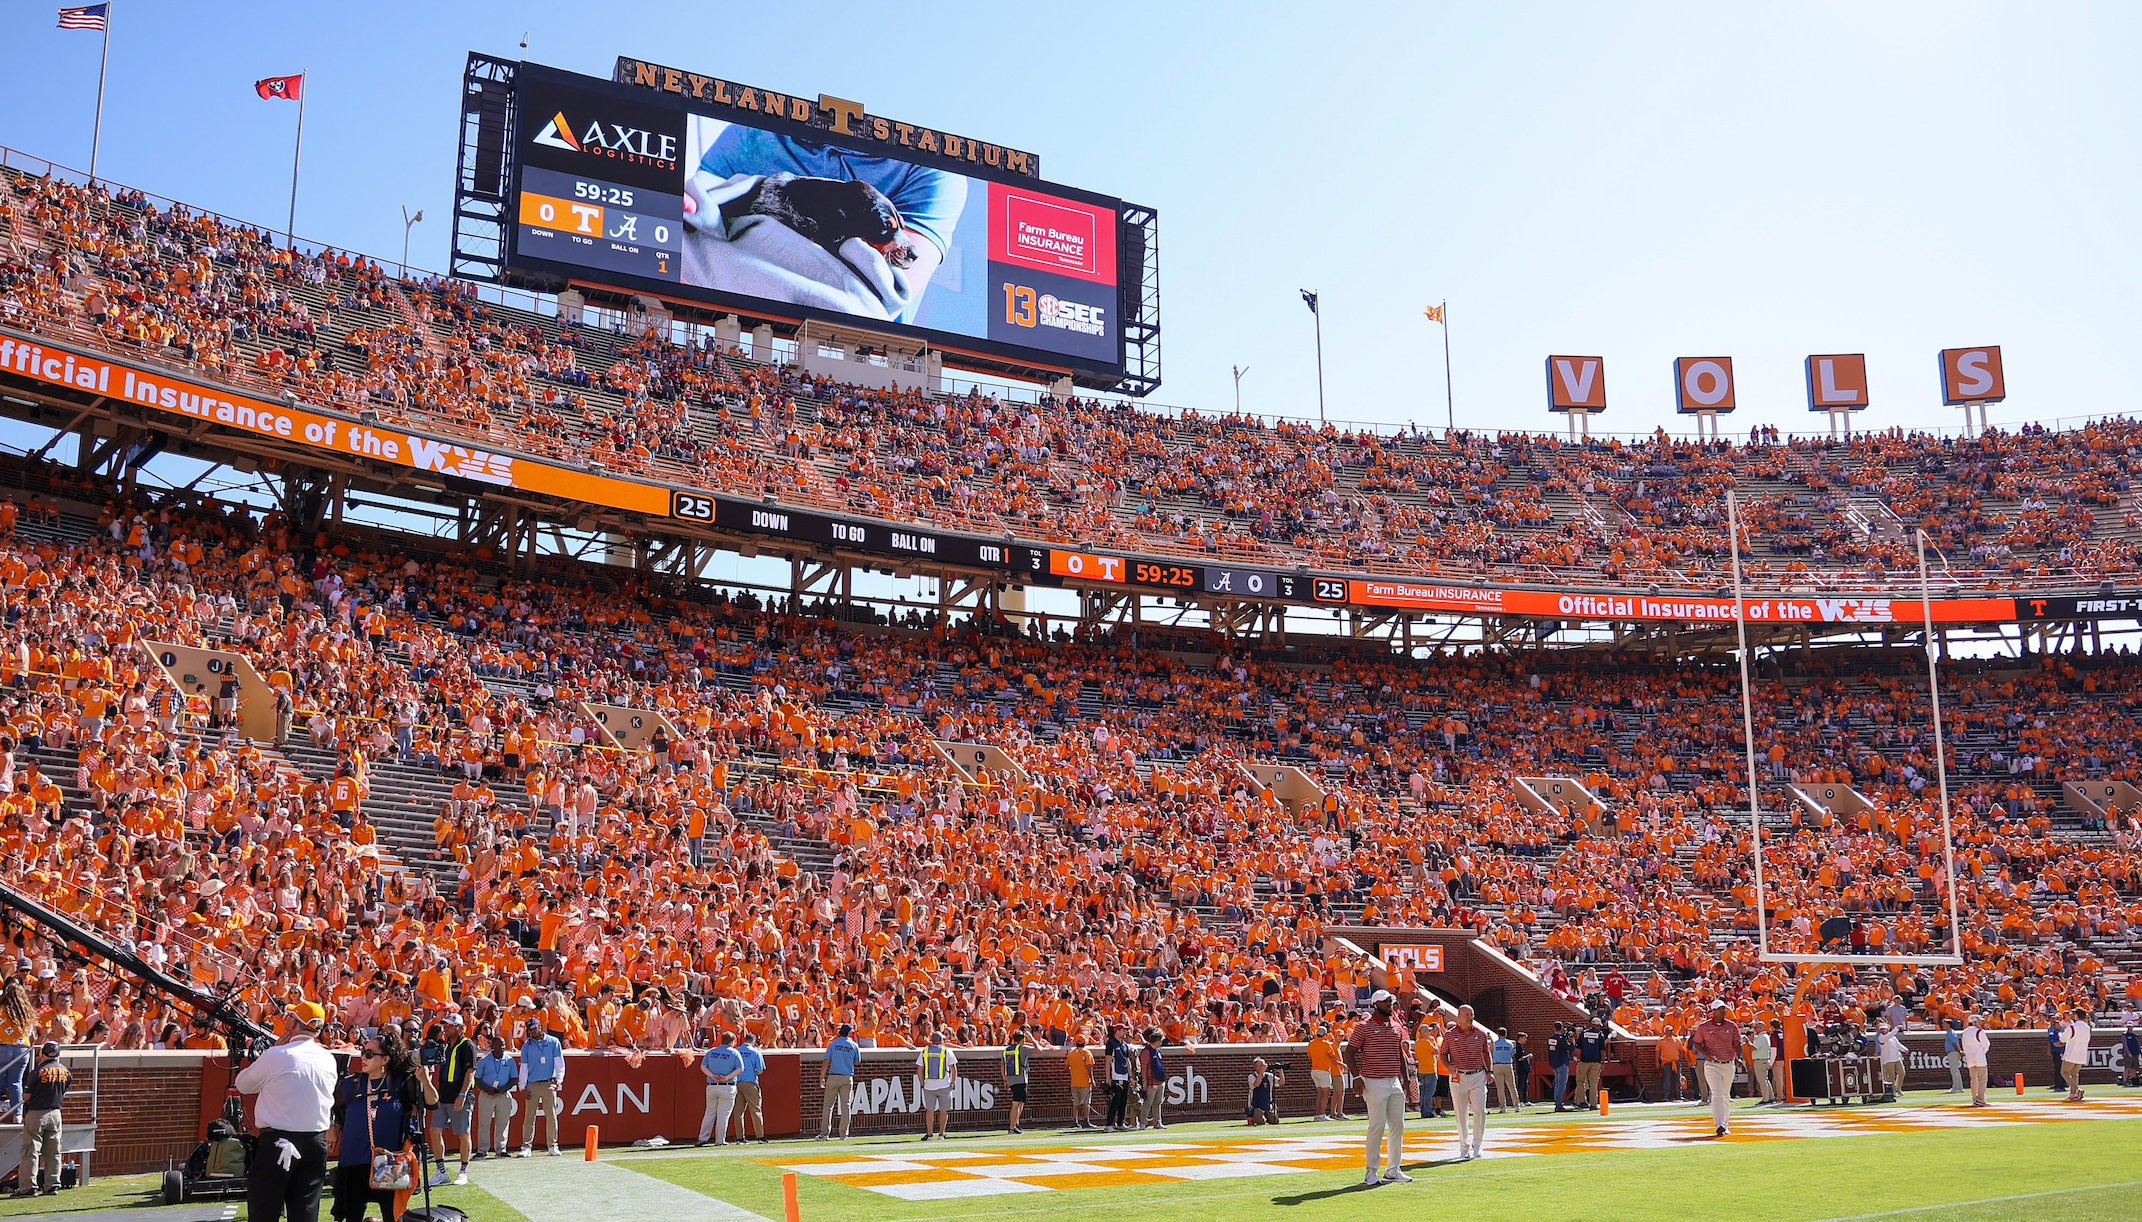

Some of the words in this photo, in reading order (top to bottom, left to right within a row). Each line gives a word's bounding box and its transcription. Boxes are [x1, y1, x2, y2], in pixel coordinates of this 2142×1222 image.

[634, 62, 810, 121] NEYLAND
[873, 118, 1028, 173] STADIUM
[582, 120, 677, 162] AXLE
[583, 144, 676, 170] LOGISTICS
[574, 181, 634, 206] 59:25
[540, 203, 554, 221] 0
[571, 205, 600, 233] T
[654, 226, 669, 243] 0
[1018, 221, 1046, 236] Farm
[1048, 228, 1084, 244] Bureau
[531, 228, 554, 239] DOWN
[572, 235, 581, 244] TO
[582, 237, 593, 246] GO
[611, 243, 627, 252] BALL
[628, 246, 639, 254] ON
[1017, 233, 1084, 256] INSURANCE
[656, 252, 670, 260] QTR
[658, 261, 668, 273] 1
[1003, 282, 1036, 328] 13
[1059, 300, 1105, 325] SEC
[1040, 313, 1105, 337] CHAMPIONSHIPS
[123, 370, 292, 436] Insurance
[304, 419, 336, 446] of
[348, 427, 399, 459] the
[679, 497, 711, 518] 25
[752, 510, 788, 531] DOWN
[831, 523, 848, 541] TO
[848, 525, 865, 543] GO
[891, 533, 918, 551] BALL
[920, 537, 935, 554] ON
[1029, 549, 1042, 557] TOL
[979, 545, 1000, 562] QTR
[1003, 547, 1009, 563] 1
[1031, 558, 1041, 570] 3
[1067, 555, 1083, 573] 0
[1098, 557, 1119, 580] T
[1136, 564, 1194, 586] 59:25
[1248, 574, 1262, 593] 0
[1282, 577, 1294, 585] TOL
[1284, 585, 1293, 597] 3
[1318, 582, 1343, 599] 25
[1366, 583, 1394, 596] Farm
[1397, 584, 1434, 598] Bureau
[1435, 587, 1502, 602] INSURANCE
[1475, 604, 1503, 612] Tennessee
[1558, 595, 1633, 616] Official
[1641, 598, 1738, 619] Insurance
[1749, 602, 1770, 619] of
[1777, 602, 1812, 619] the
[211, 661, 220, 671] J
[632, 717, 640, 727] K
[336, 785, 349, 800] 16
[785, 1003, 800, 1020] 16
[513, 1020, 526, 1038] 16
[39, 1066, 69, 1076] EVENT
[41, 1074, 68, 1083] STAFF
